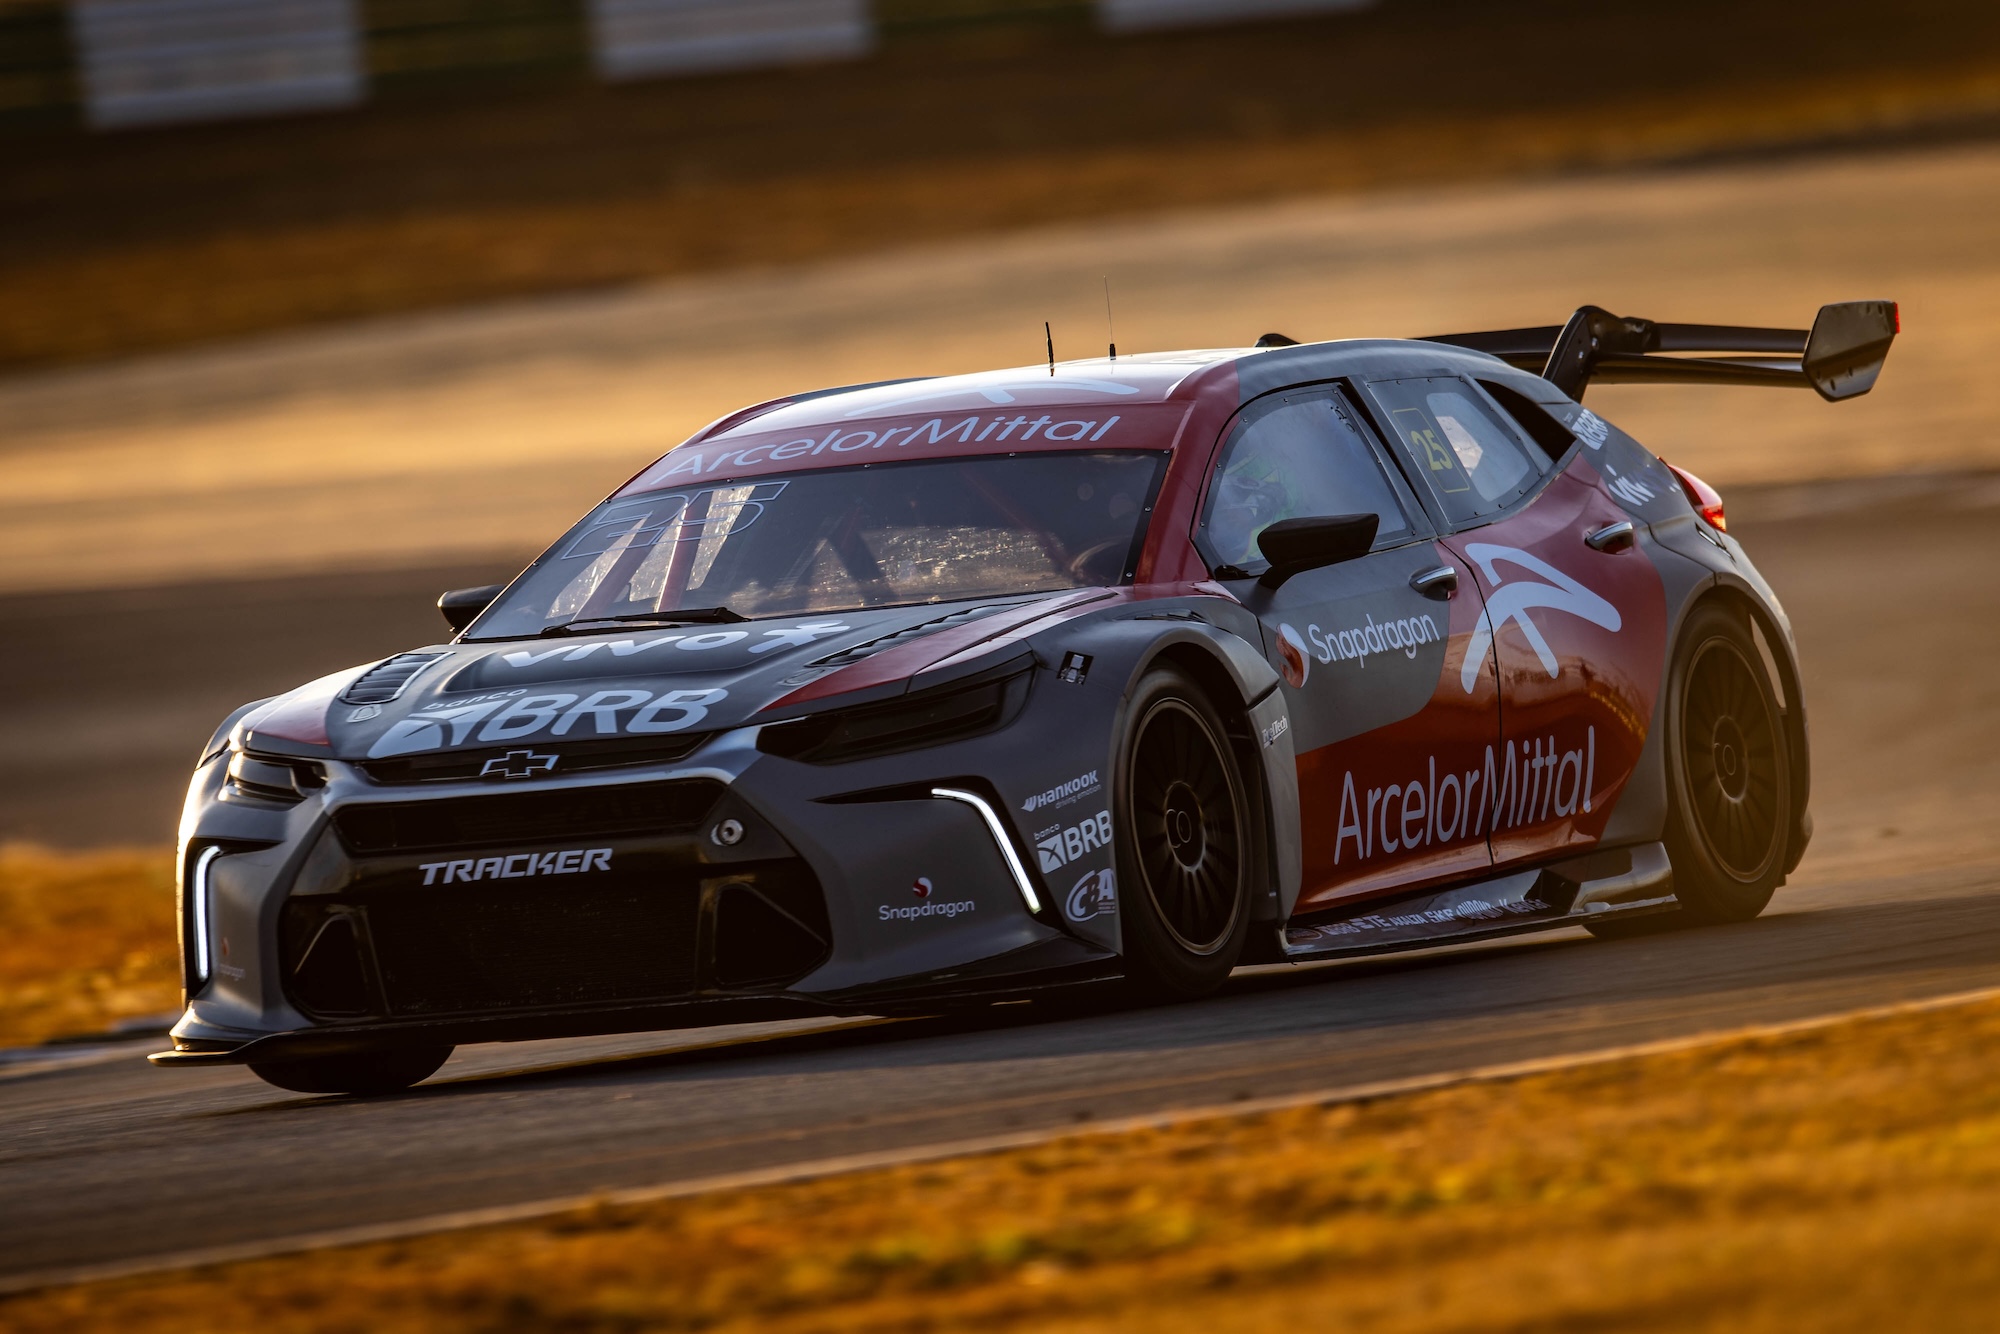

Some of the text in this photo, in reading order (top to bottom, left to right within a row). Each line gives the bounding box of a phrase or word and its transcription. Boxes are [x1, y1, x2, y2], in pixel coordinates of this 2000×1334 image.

[649, 414, 1121, 486] ArcelorMittal
[1410, 429, 1454, 472] 25
[560, 480, 791, 561] 25
[1307, 612, 1441, 669] Snapdragon
[421, 687, 529, 711] banco
[477, 686, 729, 743] BRB
[1333, 725, 1596, 867] ArcelorMittal
[1033, 822, 1061, 841] banco
[1062, 808, 1114, 863] BRB
[419, 847, 613, 887] TRACKER
[879, 899, 975, 922] Snapdragon
